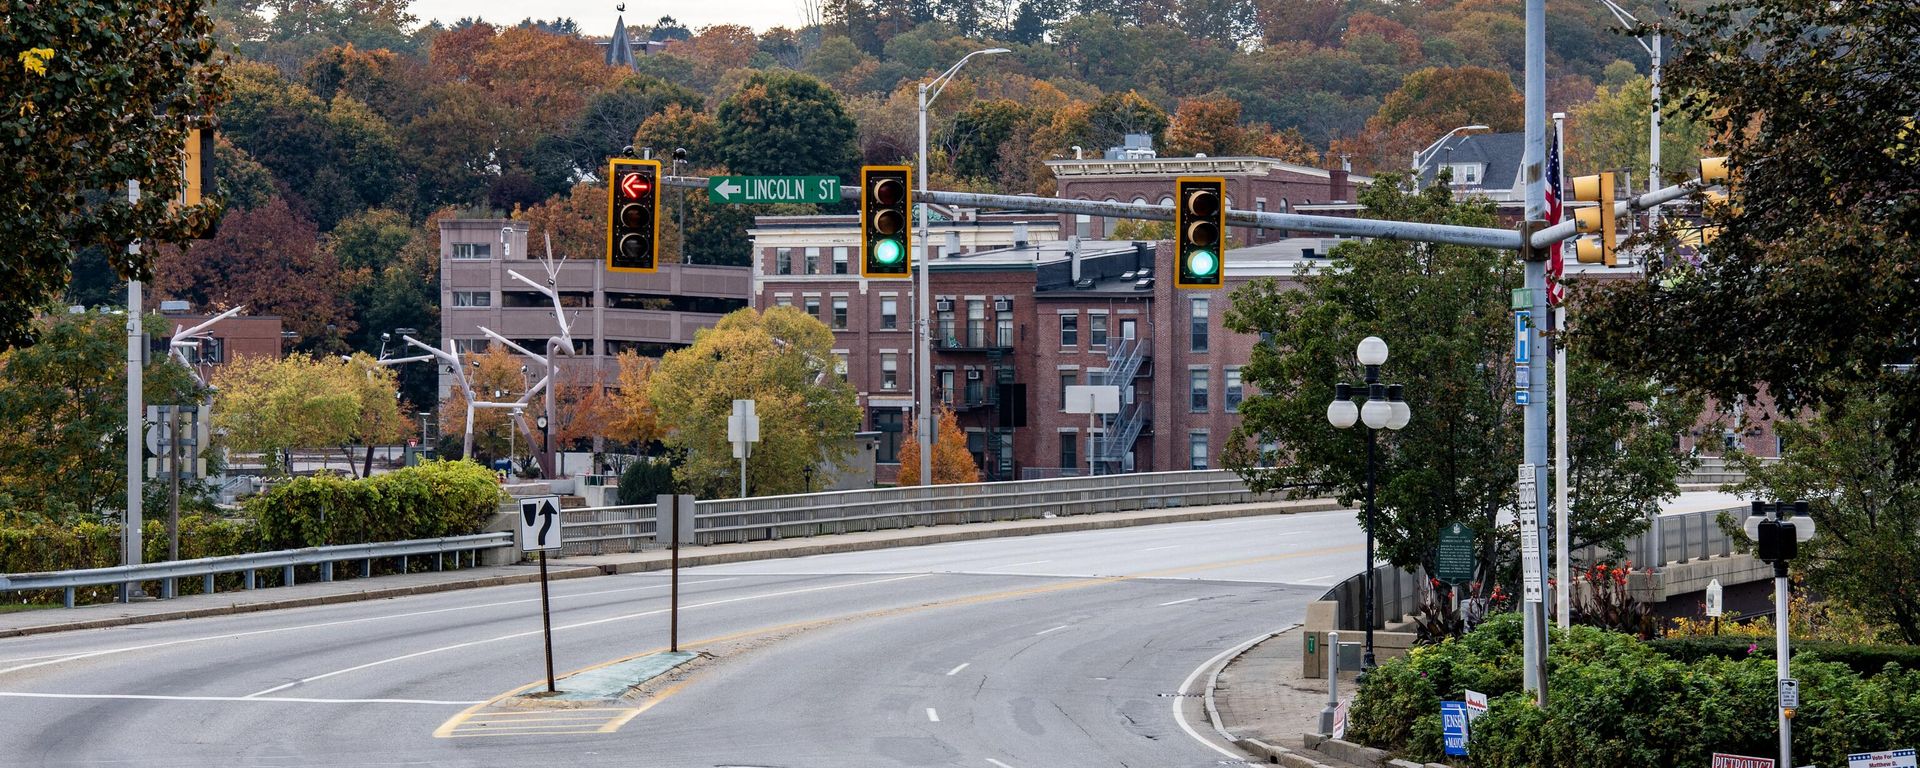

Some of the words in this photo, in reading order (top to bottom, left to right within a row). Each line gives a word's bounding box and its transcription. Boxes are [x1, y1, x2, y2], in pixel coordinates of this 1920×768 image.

[745, 179, 805, 200] LINCOLN
[818, 179, 836, 200] ST
[1443, 714, 1464, 732] JENSE
[1448, 737, 1463, 749] MAYO
